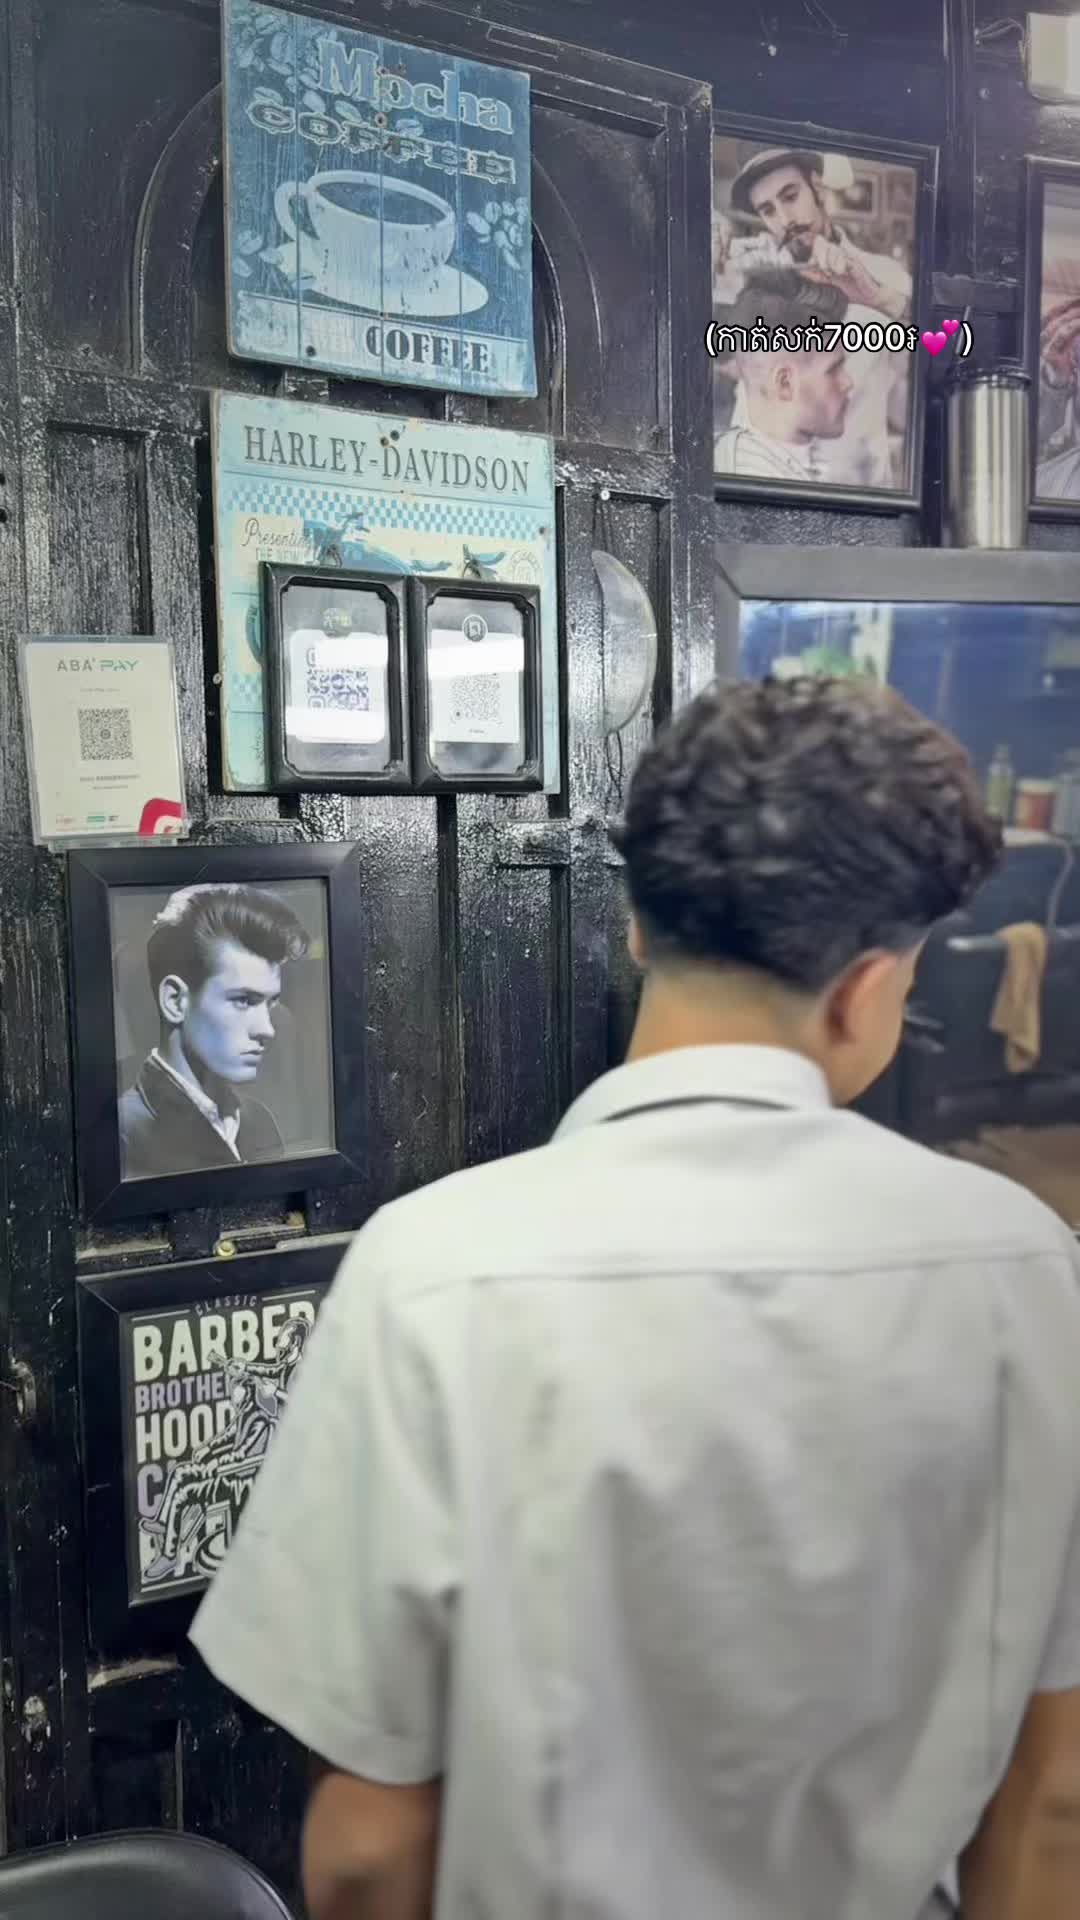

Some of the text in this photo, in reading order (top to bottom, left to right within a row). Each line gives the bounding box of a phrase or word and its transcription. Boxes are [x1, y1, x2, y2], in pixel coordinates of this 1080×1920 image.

[316, 40, 512, 134] Mocha
[365, 325, 490, 373] COFFEE
[245, 425, 530, 493] HARLEY-DAVIDSON
[99, 659, 139, 672] PAY
[195, 1294, 258, 1317] CLASSIC
